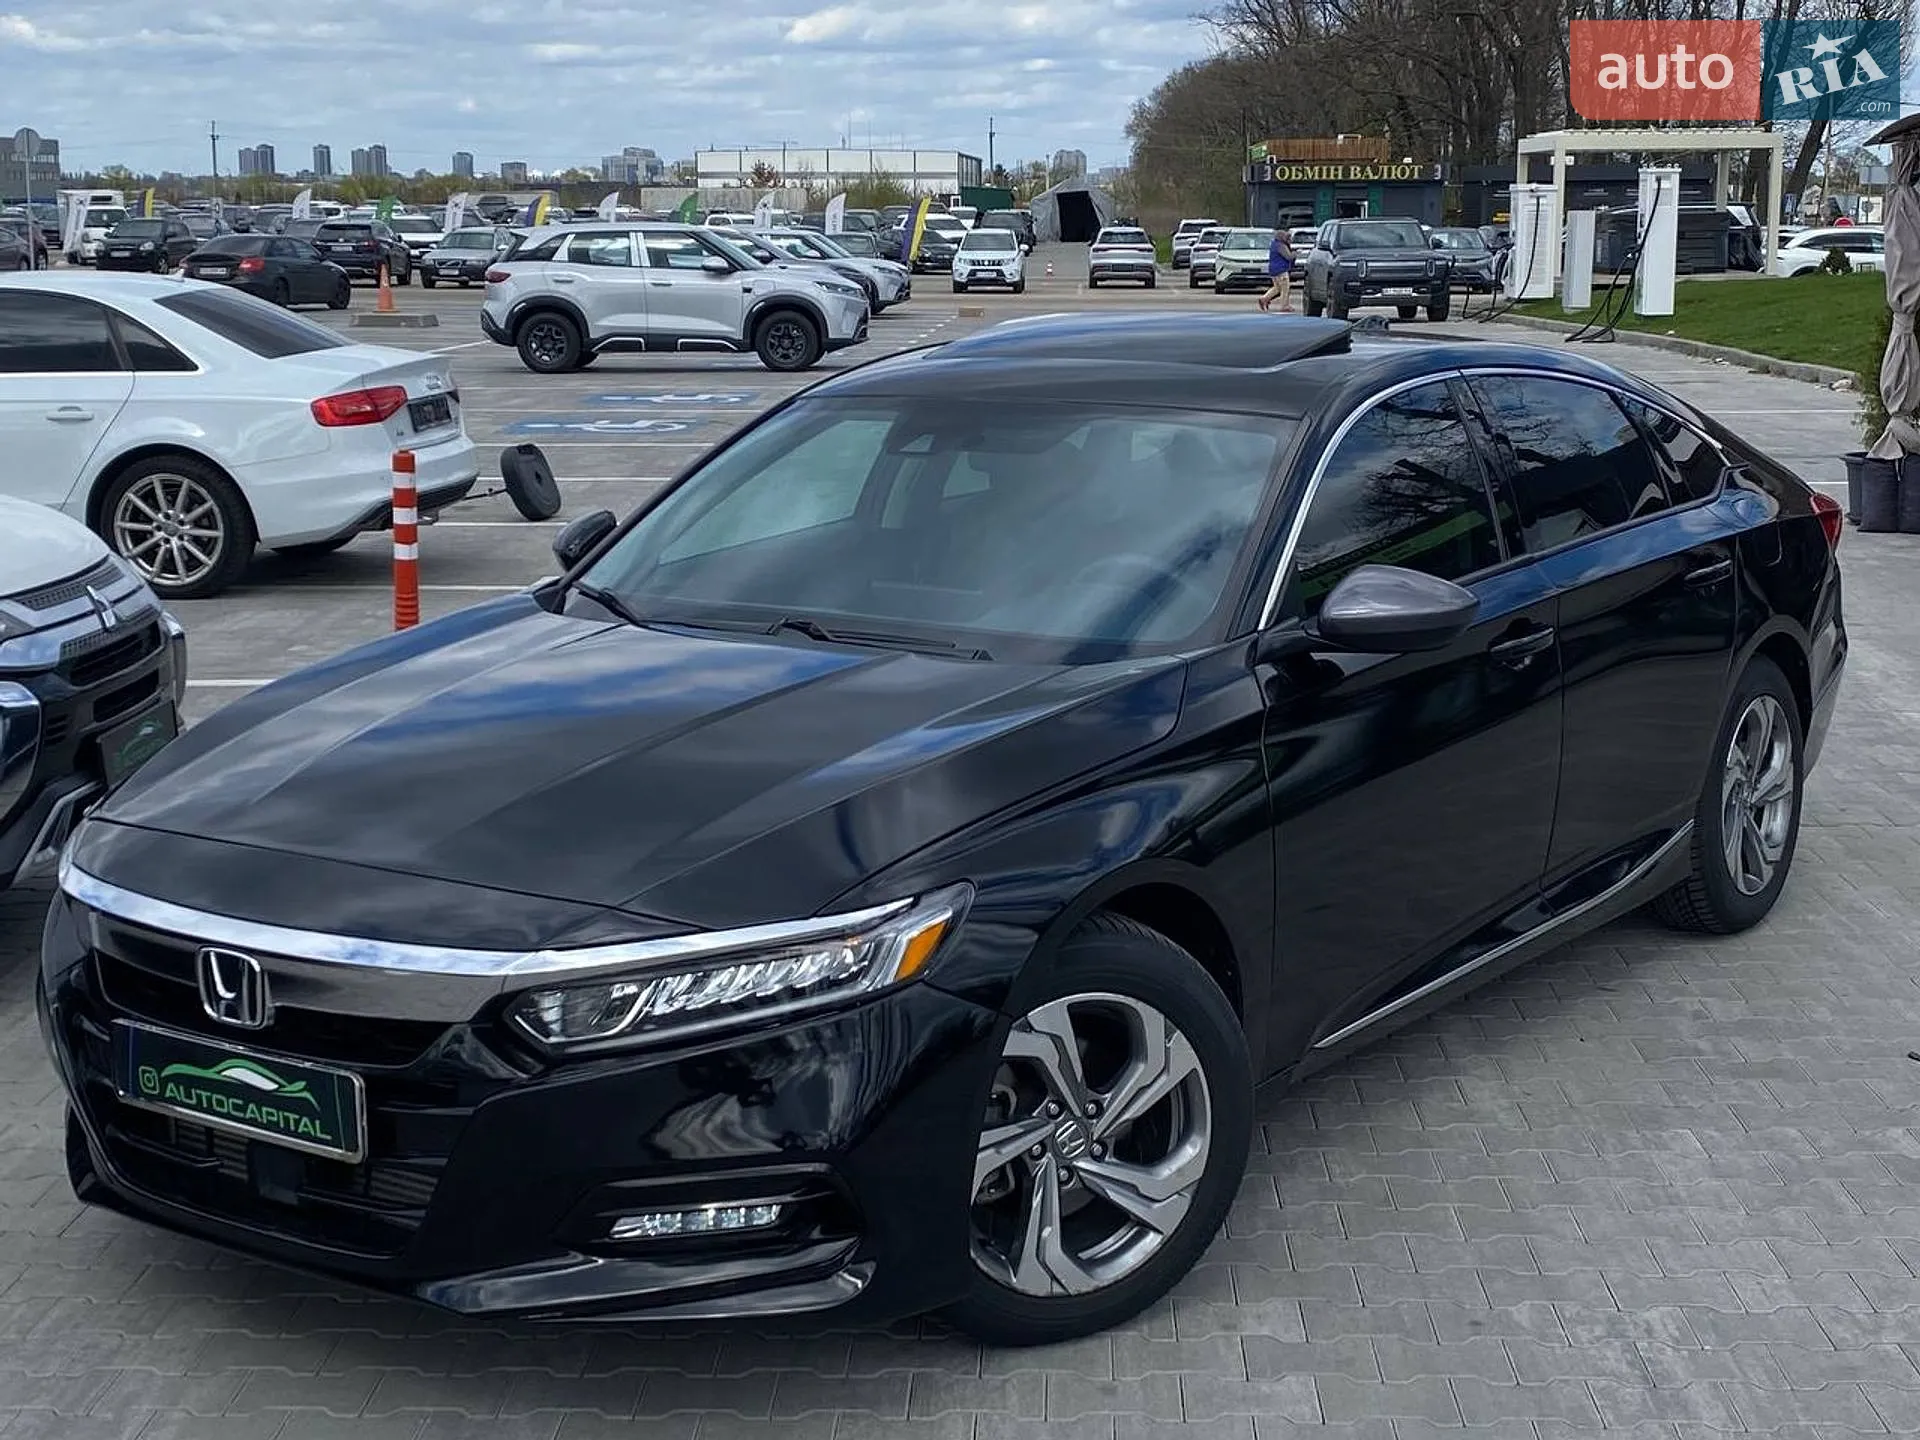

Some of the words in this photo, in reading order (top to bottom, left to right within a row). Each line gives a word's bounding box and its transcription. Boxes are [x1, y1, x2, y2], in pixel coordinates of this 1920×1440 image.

[1275, 165, 1343, 181] ОБМІН
[1349, 164, 1424, 181] ВАЛЮТ
[164, 1082, 332, 1140] AUTOCAPITAL
